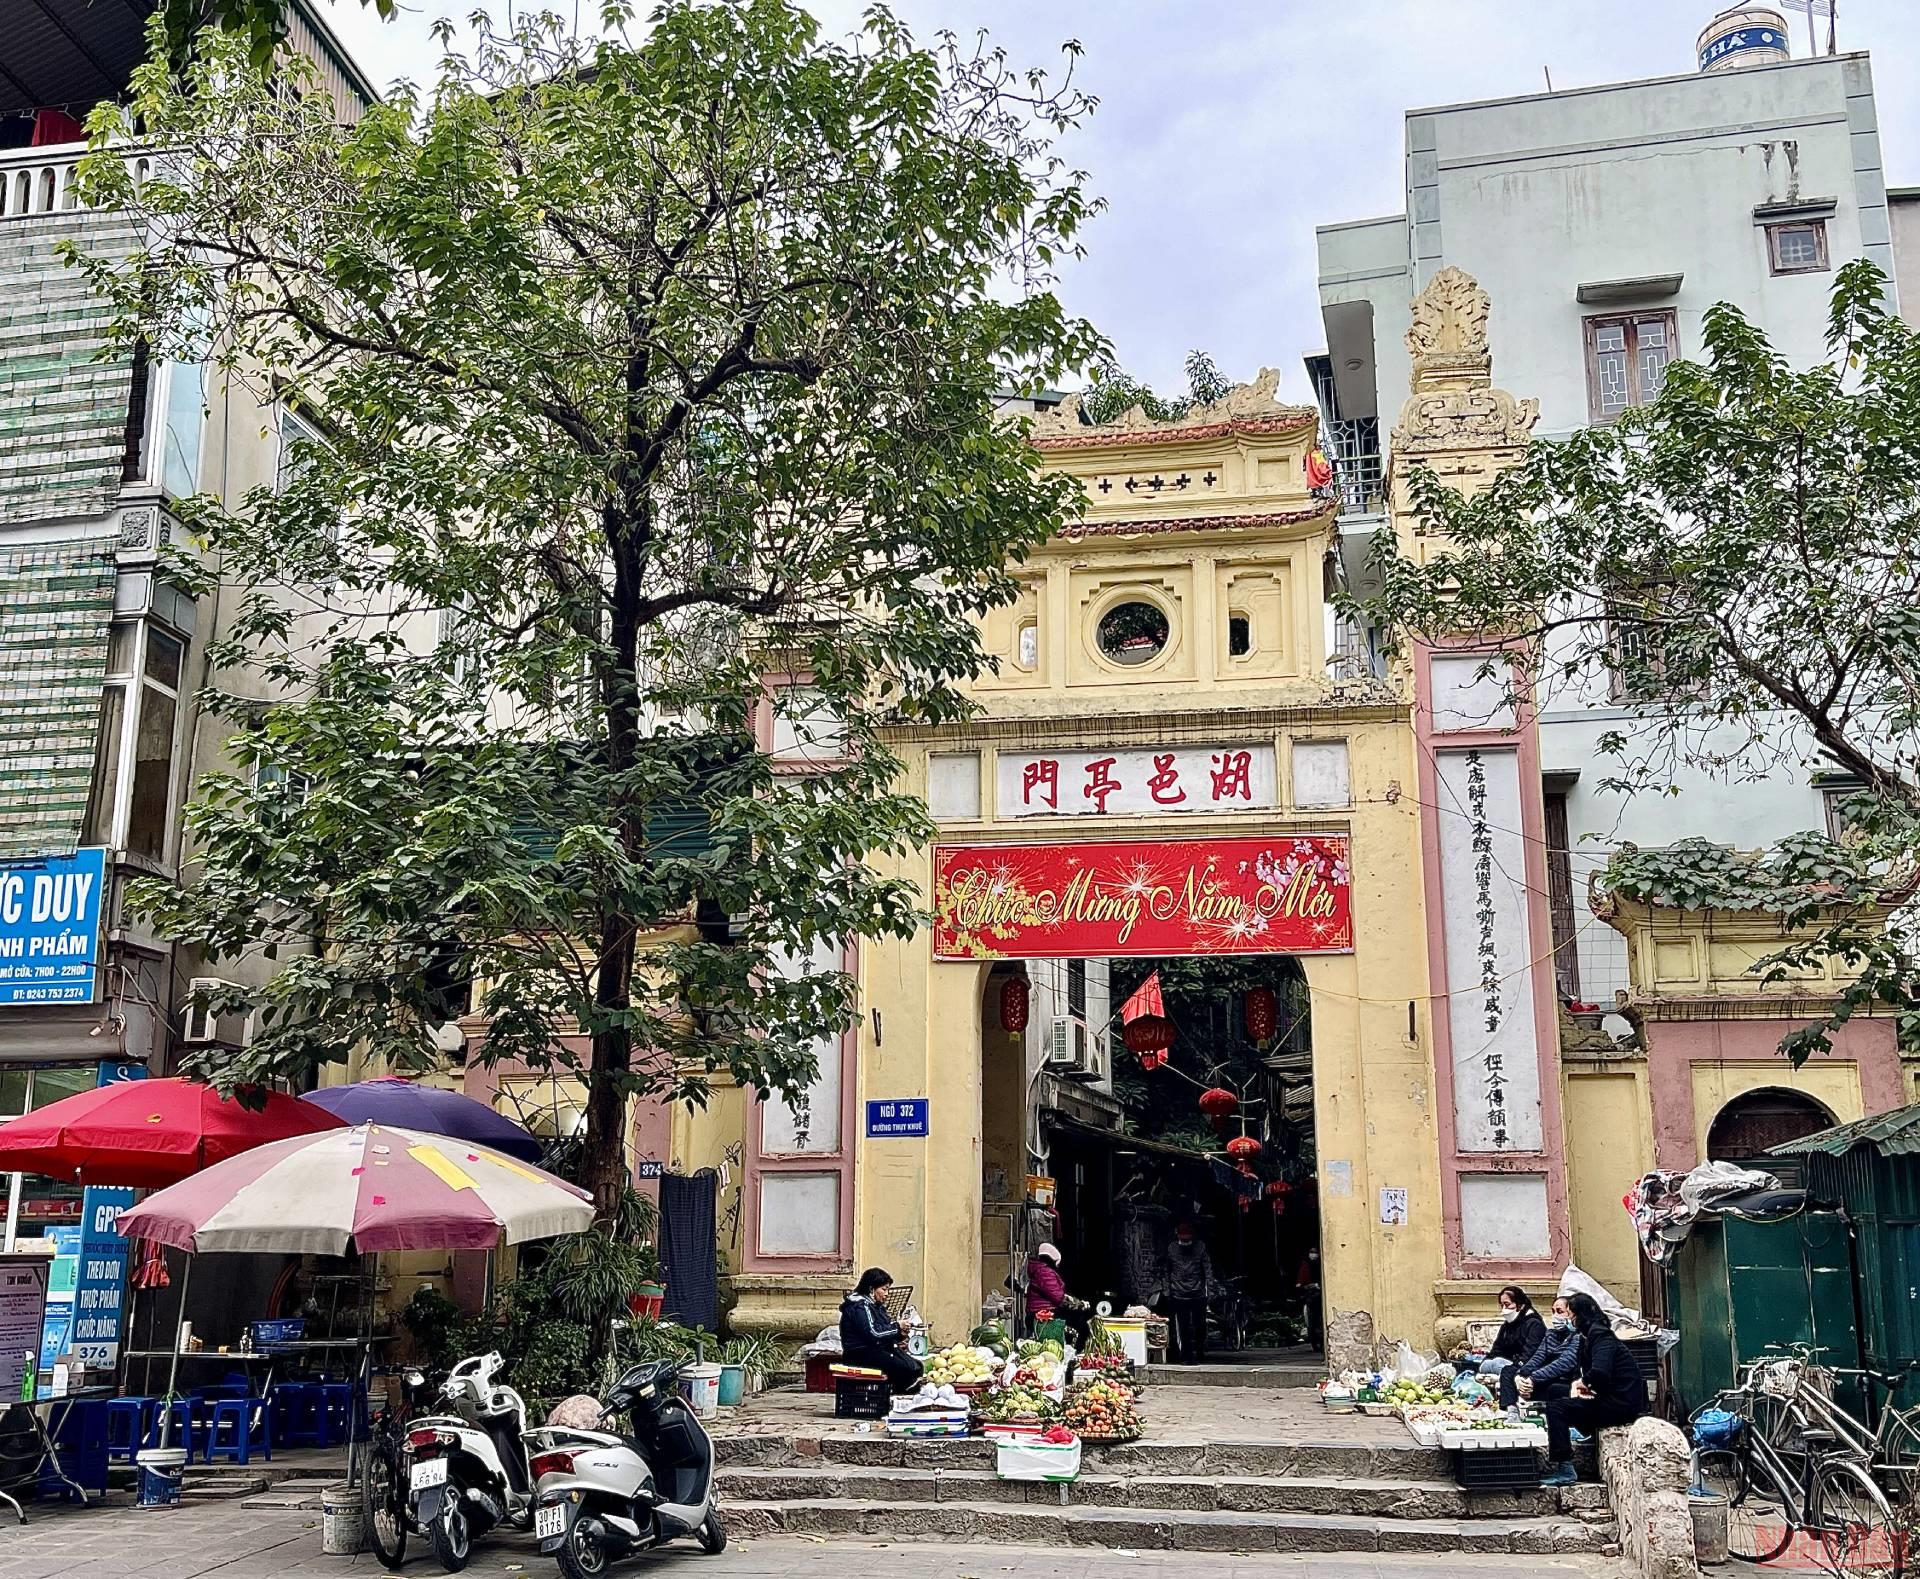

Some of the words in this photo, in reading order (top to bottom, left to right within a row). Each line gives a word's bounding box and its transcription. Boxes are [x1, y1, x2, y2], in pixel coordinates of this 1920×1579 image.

[32, 873, 94, 922] DUY
[951, 868, 1024, 931] Chúc
[1035, 868, 1141, 944] Mừng
[1150, 865, 1243, 920] Năm
[1255, 865, 1338, 919] Mới
[29, 928, 88, 956] PHẨM
[35, 966, 54, 976] 7H00
[61, 964, 86, 977] 22H00
[27, 988, 46, 999] 0243
[48, 988, 62, 999] 753
[64, 987, 84, 998] 2374
[880, 1103, 895, 1117] NGÕ
[900, 1105, 914, 1117] 372
[642, 1164, 661, 1176] 374
[87, 1260, 104, 1279] THEO
[105, 1260, 120, 1279] ĐƠN
[81, 1287, 98, 1313] THỰC
[77, 1314, 96, 1338] CHỨC
[96, 1316, 117, 1337] NĂNG
[80, 1346, 107, 1358] 376
[539, 1520, 561, 1536] 8126
